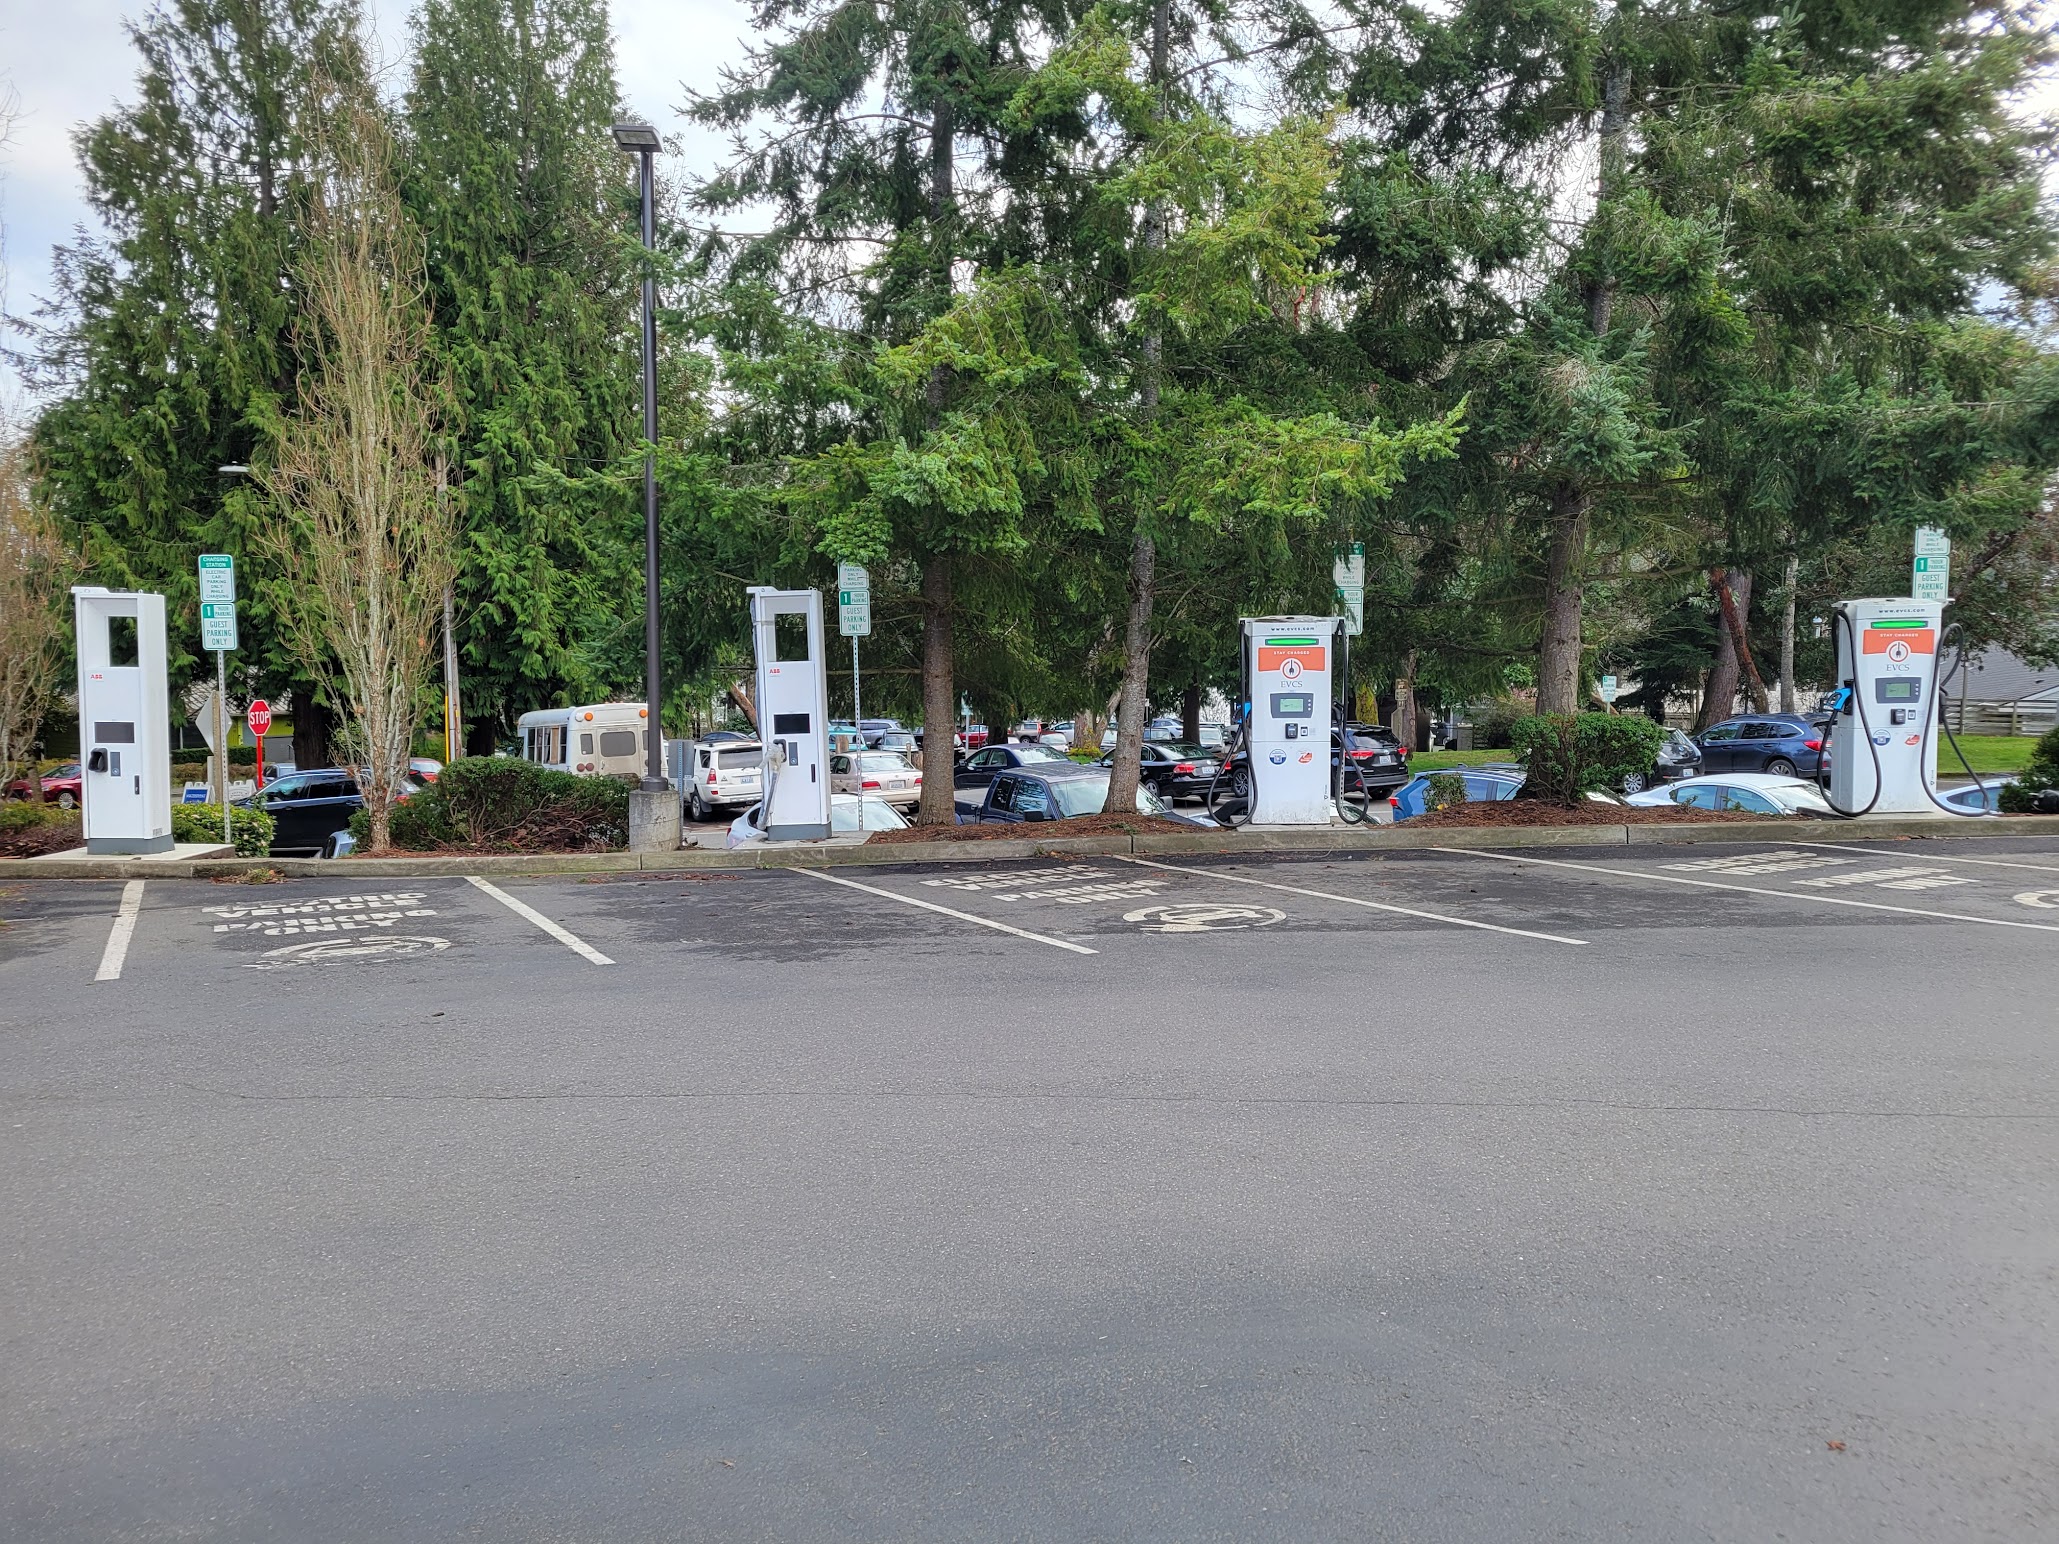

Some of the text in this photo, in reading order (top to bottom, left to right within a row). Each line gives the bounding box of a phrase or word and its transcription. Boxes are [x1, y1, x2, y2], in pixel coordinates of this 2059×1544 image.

[1918, 582, 1944, 591] PARKING
[1921, 591, 1938, 599] ONLY
[206, 629, 232, 637] PARKING
[848, 623, 862, 631] ONLY
[1280, 680, 1303, 688] EVCS
[250, 711, 270, 725] STOP
[949, 871, 1116, 891] VEHICLE
[1873, 875, 1982, 890] ONLY
[991, 879, 1171, 902] PARKING
[1055, 888, 1162, 904] ONLY
[214, 898, 422, 918] VEHICLE
[263, 918, 399, 936] ONLY
